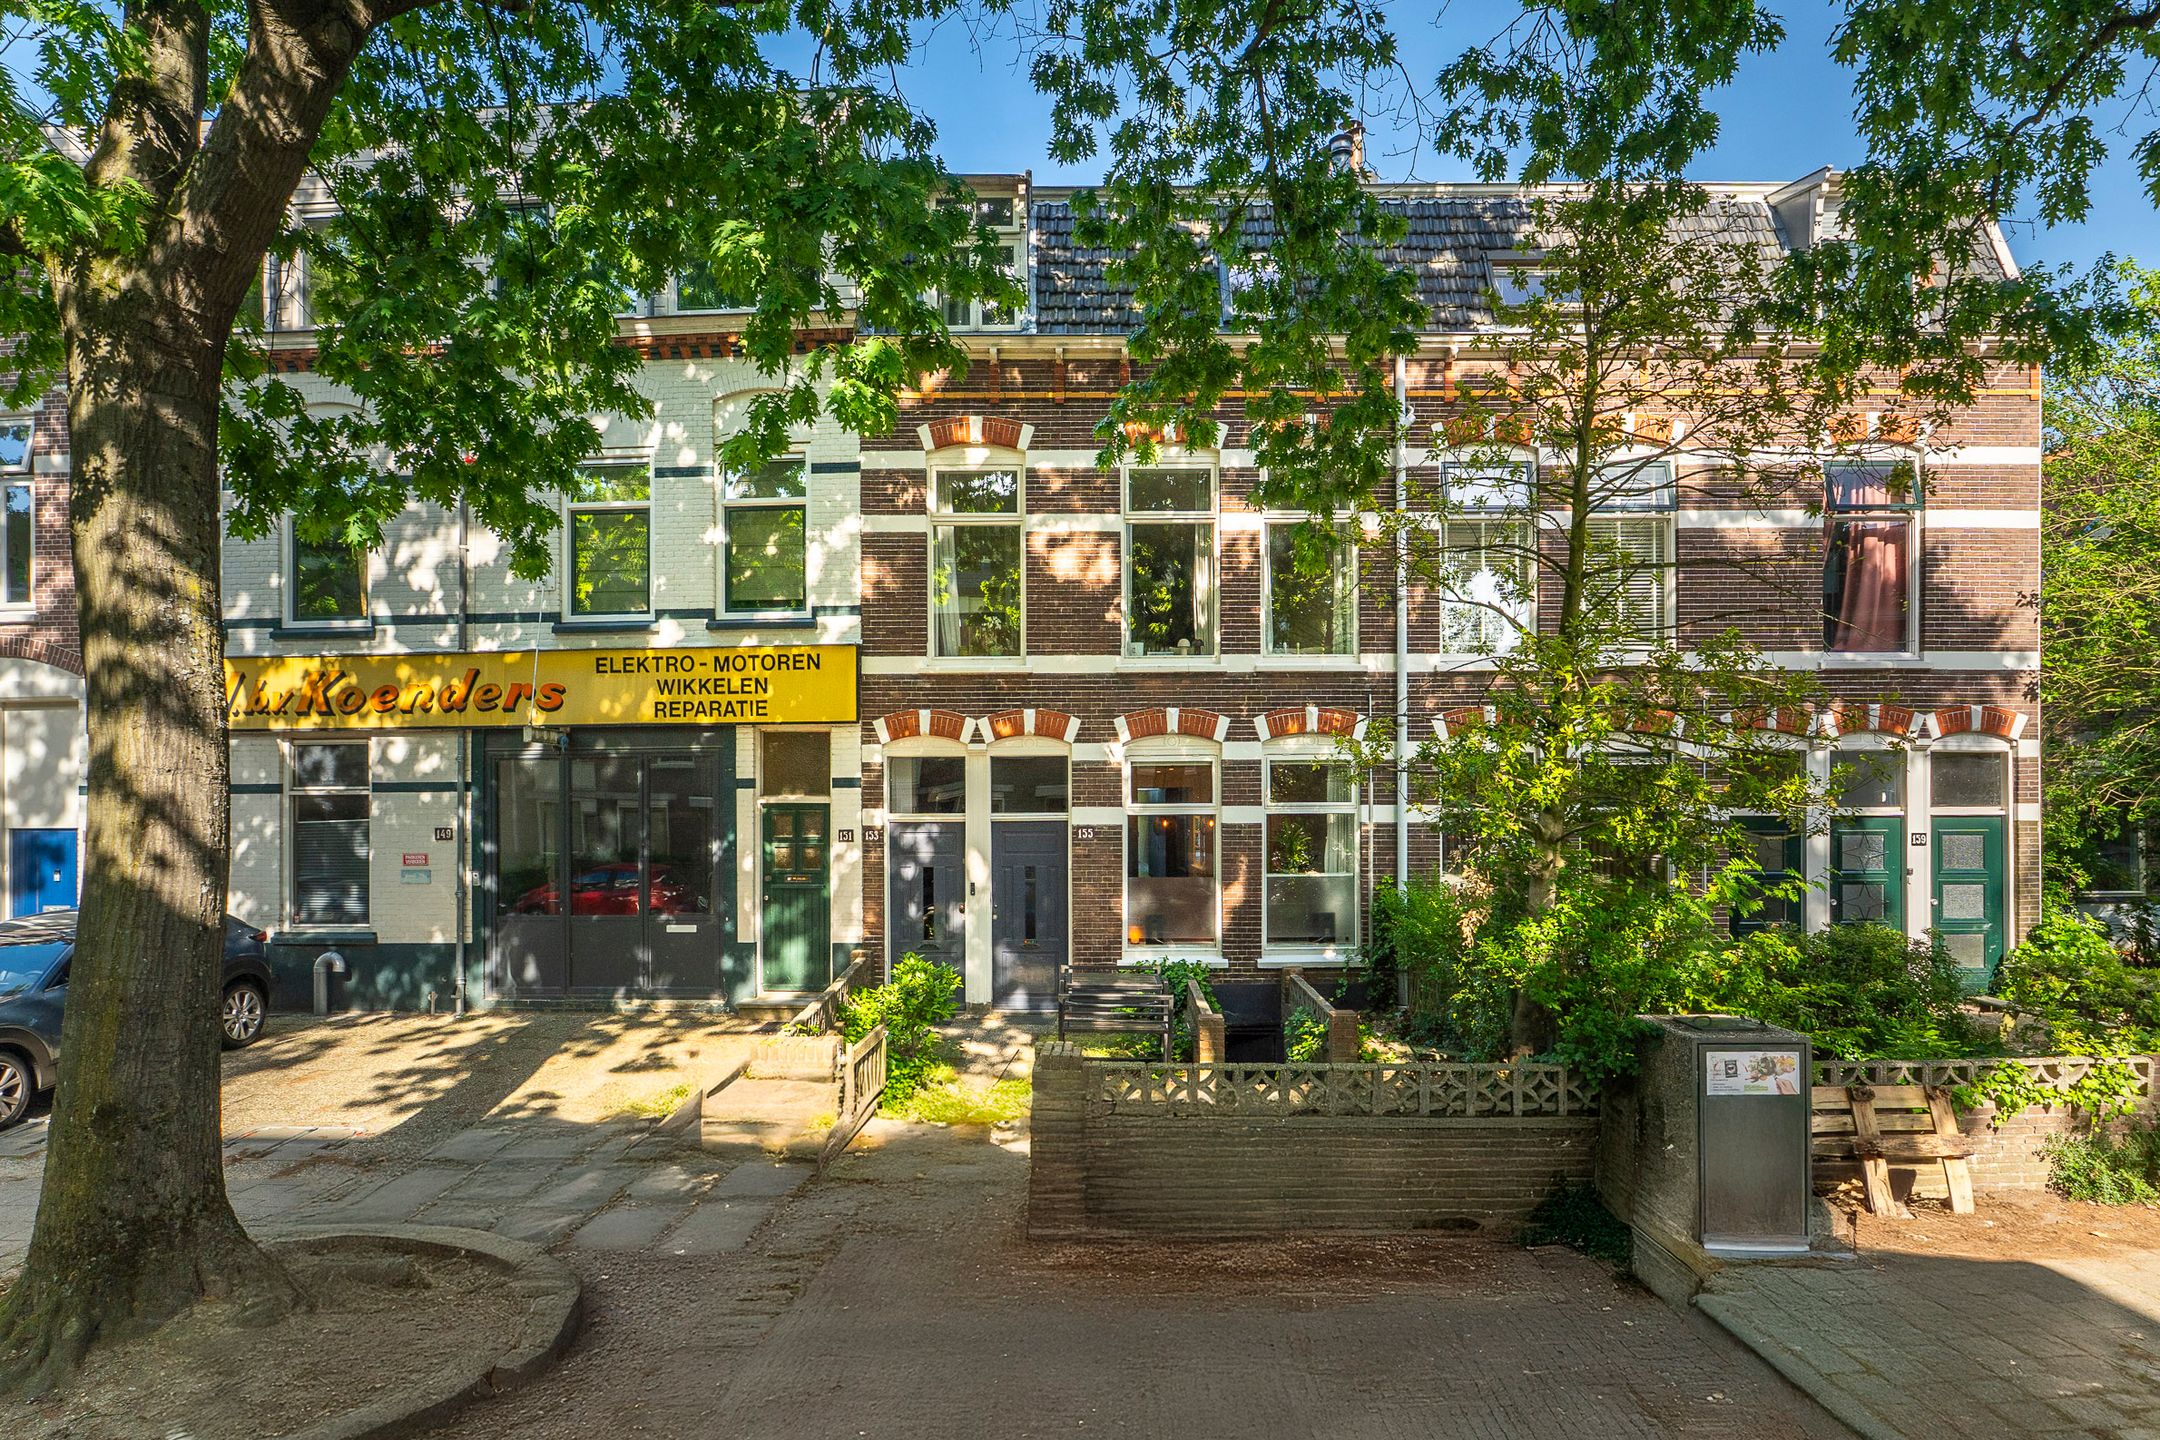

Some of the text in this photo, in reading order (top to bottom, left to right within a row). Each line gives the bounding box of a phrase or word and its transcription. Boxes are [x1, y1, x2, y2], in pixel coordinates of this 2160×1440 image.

[595, 655, 695, 674] ELEKTRO
[713, 653, 820, 673] MOTOREN
[295, 667, 567, 717] Koenders
[656, 677, 768, 696] WIKKELEN
[654, 699, 768, 718] REPARATIE
[436, 828, 452, 839] 149
[839, 830, 852, 841] 151
[865, 830, 879, 840] 153
[1077, 828, 1094, 838] 155
[1911, 834, 1926, 844] 159
